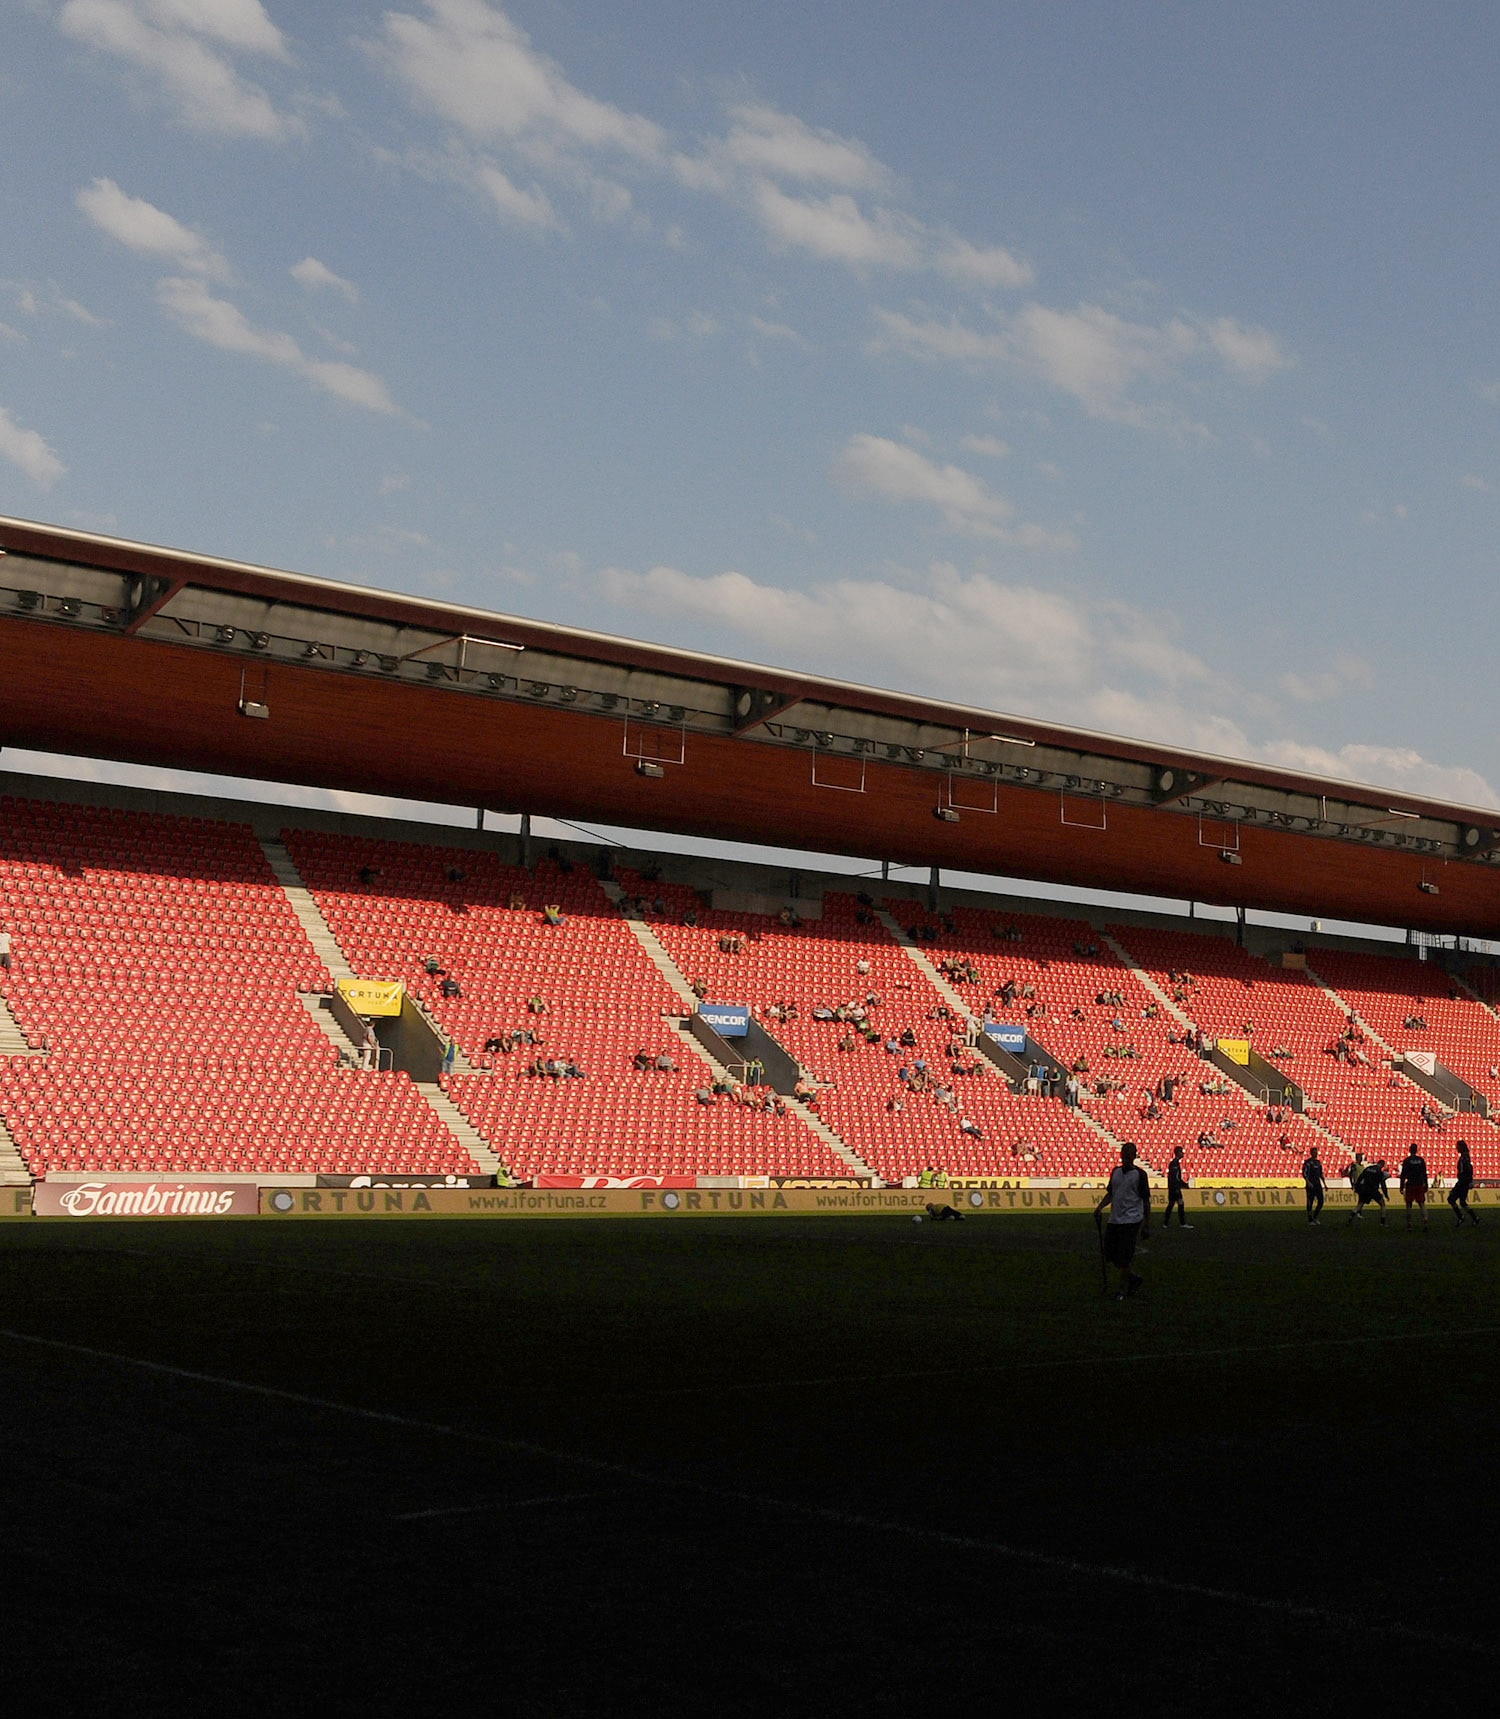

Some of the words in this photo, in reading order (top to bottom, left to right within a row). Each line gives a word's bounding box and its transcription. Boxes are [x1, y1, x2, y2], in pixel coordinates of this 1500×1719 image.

[60, 1182, 236, 1216] Gambrinus
[259, 1190, 432, 1213] ORTUNA
[468, 1192, 607, 1210] www.ifortuna.cz
[641, 1190, 788, 1212] FORTUNA
[816, 1191, 926, 1207] www.ifortuna.cz
[952, 1190, 1069, 1207] FORTUNA
[1201, 1189, 1296, 1206] FORTUNA
